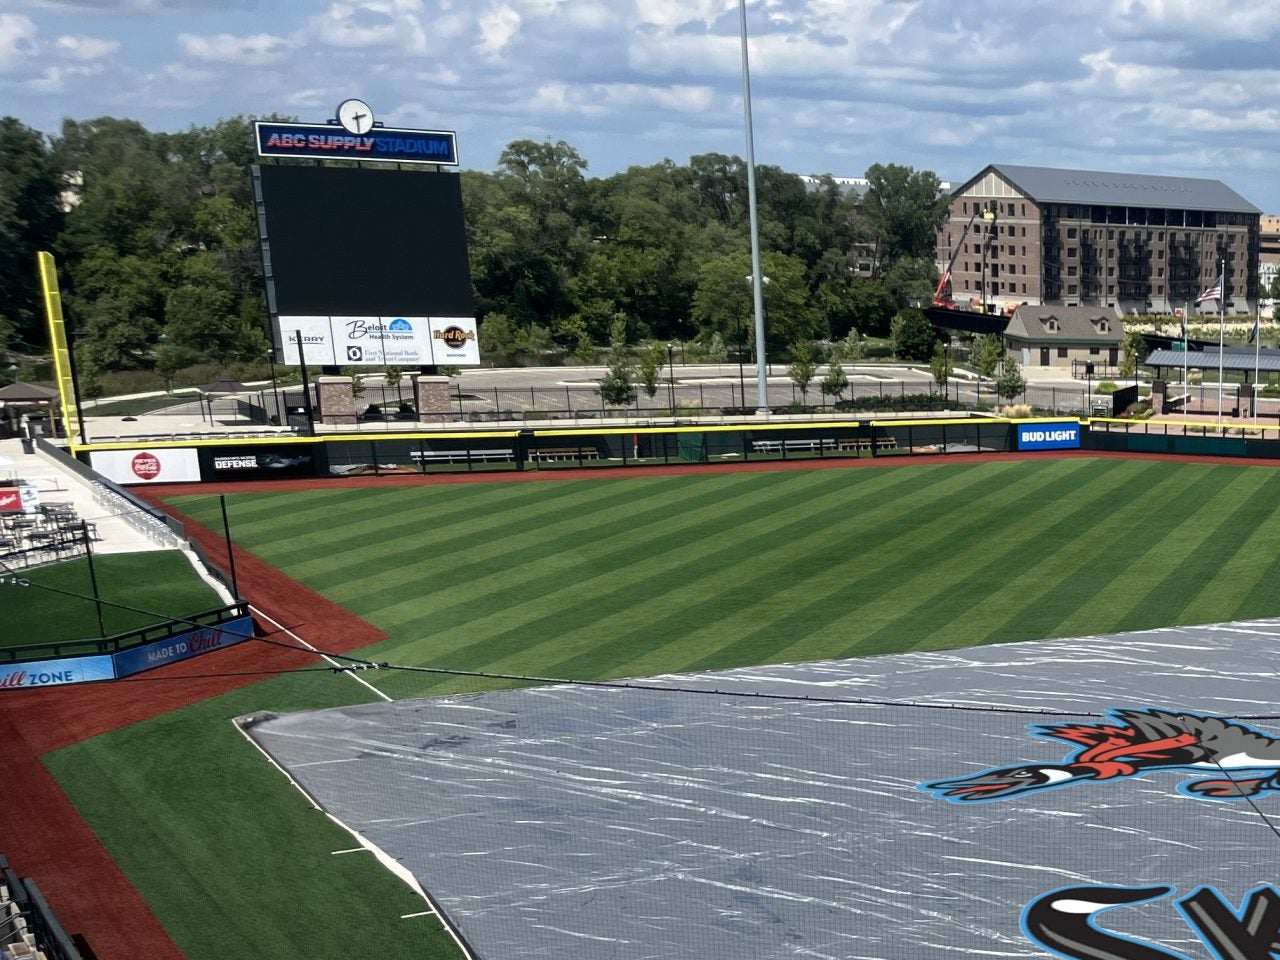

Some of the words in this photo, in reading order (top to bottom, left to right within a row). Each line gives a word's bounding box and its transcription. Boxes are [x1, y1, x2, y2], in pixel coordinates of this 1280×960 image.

[267, 133, 306, 148] ABC
[308, 135, 375, 151] SUPPLY
[375, 138, 449, 154] STADIUM
[346, 320, 387, 339] Beloit
[433, 329, 455, 340] Hard
[455, 330, 476, 341] Rock
[1022, 431, 1045, 442] BUD
[1045, 430, 1077, 441] LIGHT
[215, 460, 258, 469] DEFENSE
[147, 646, 174, 661] MADE
[175, 642, 187, 654] TO
[189, 629, 223, 655] Chill
[0, 671, 27, 688] ill
[29, 670, 73, 685] ZONE
